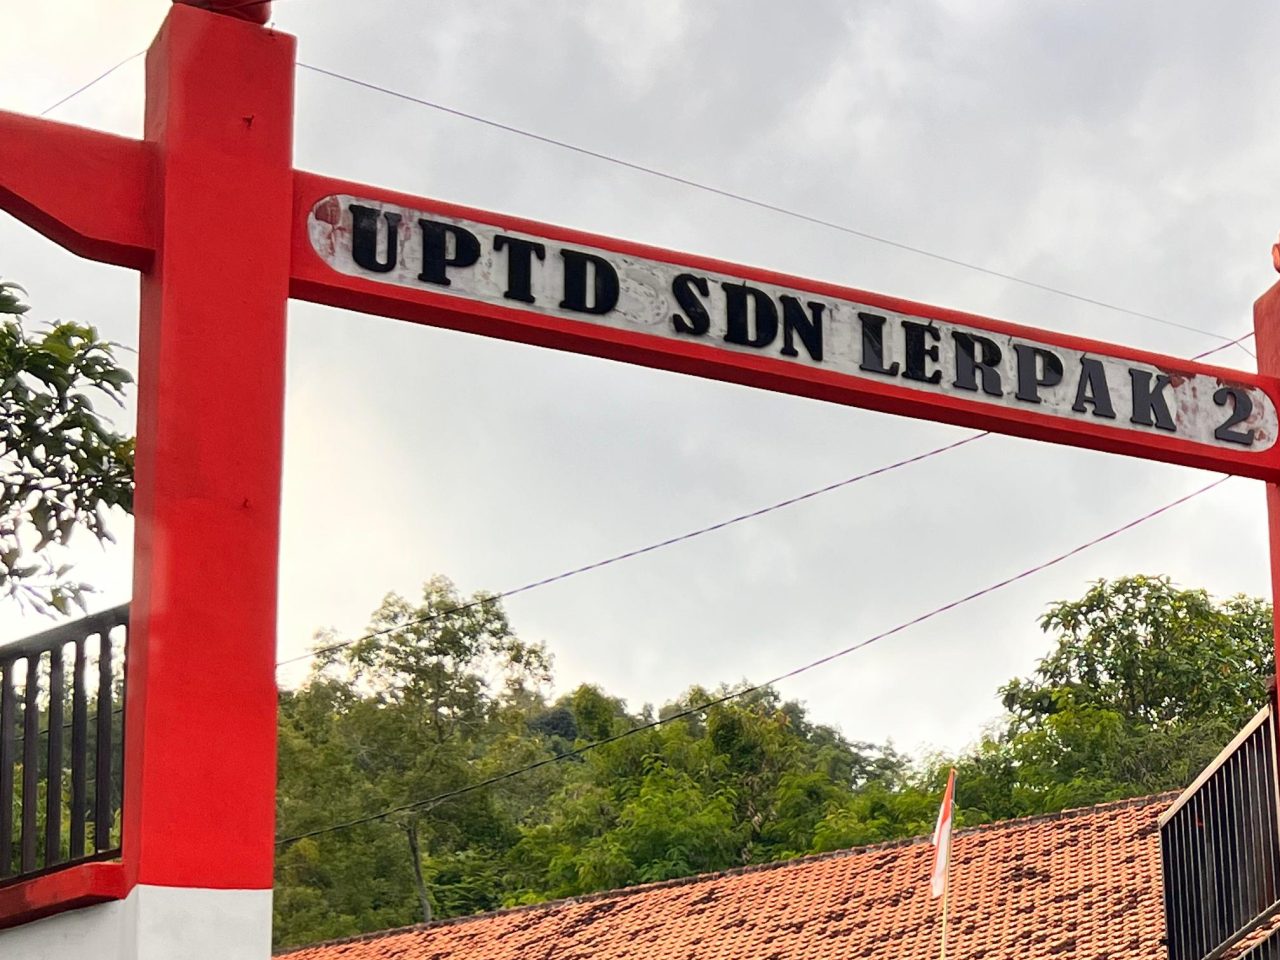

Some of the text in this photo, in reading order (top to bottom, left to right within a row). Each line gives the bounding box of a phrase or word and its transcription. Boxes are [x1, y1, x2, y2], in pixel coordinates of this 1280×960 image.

[349, 204, 1254, 445] UPTD SDN LERPAK 2
